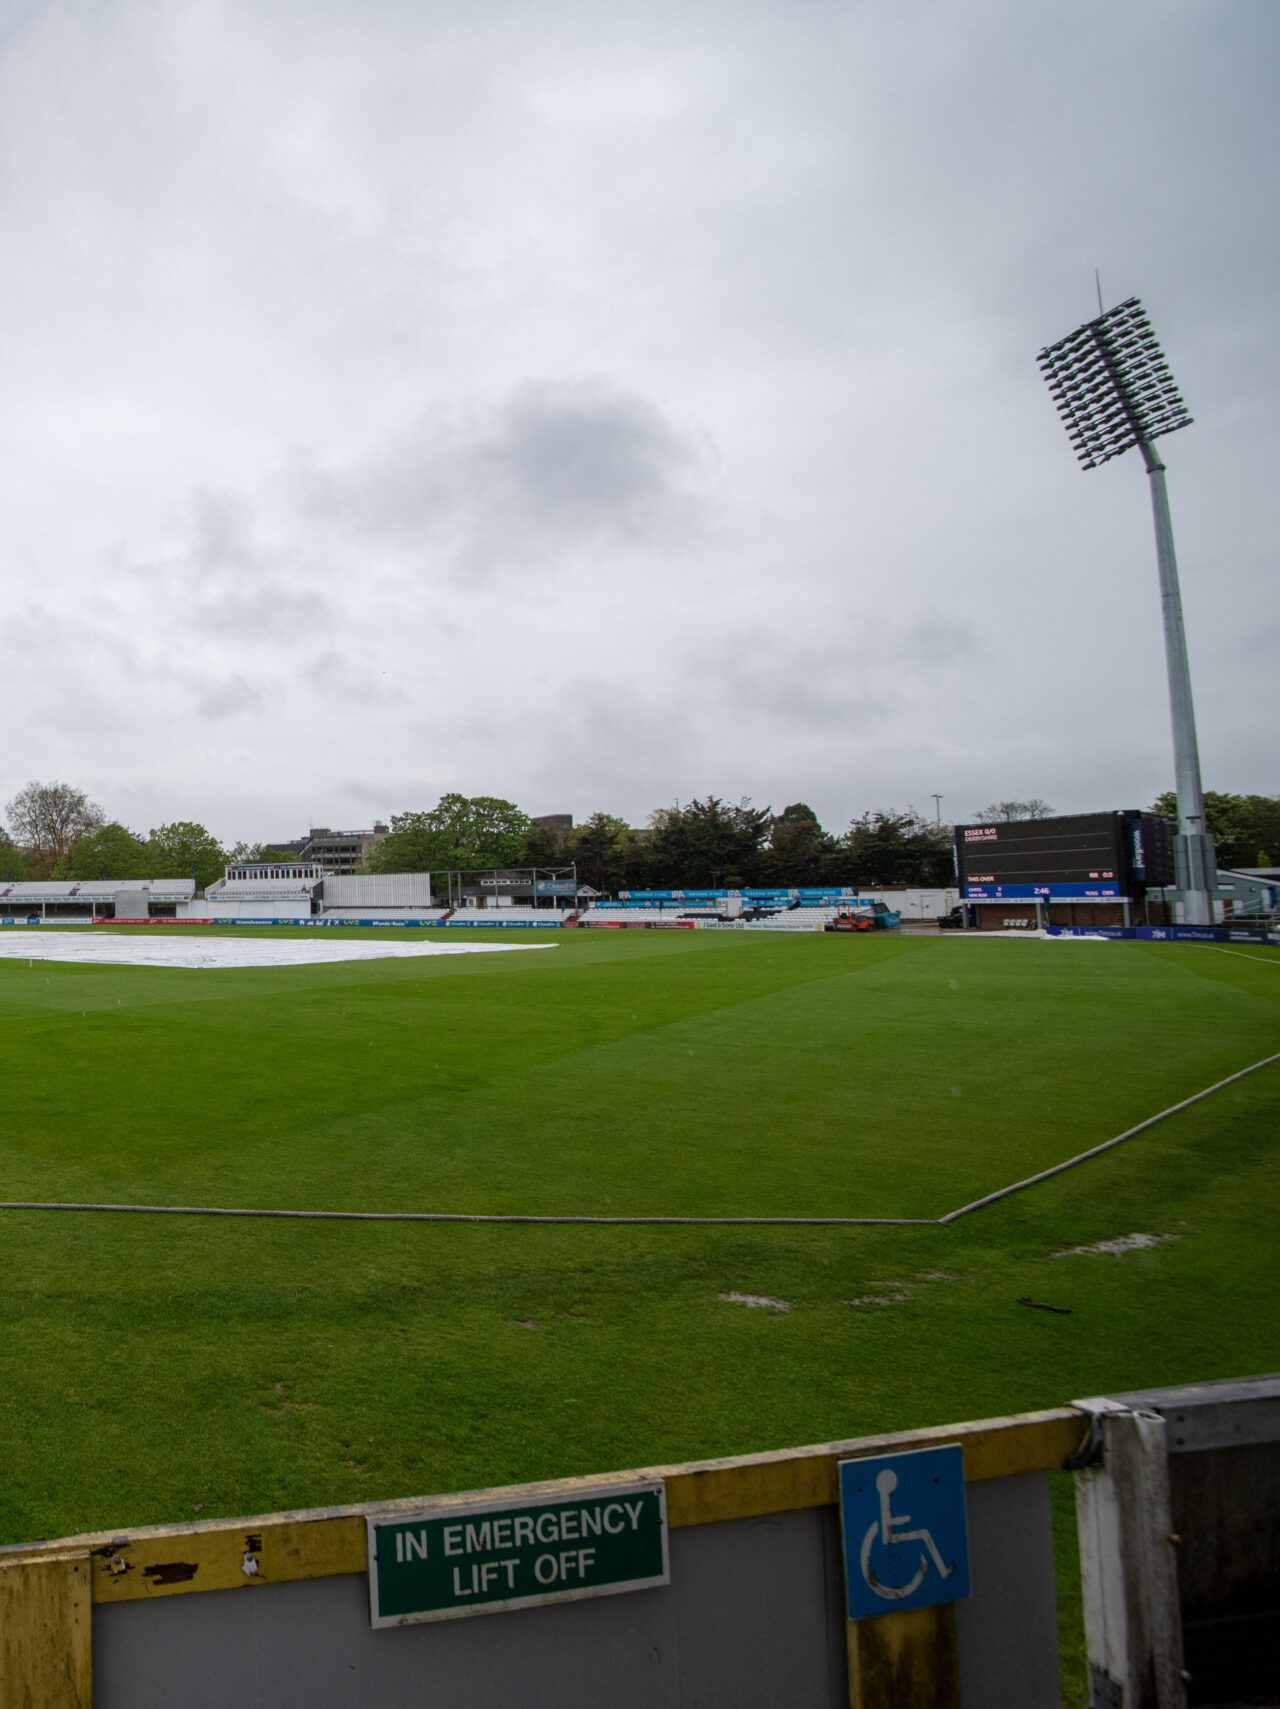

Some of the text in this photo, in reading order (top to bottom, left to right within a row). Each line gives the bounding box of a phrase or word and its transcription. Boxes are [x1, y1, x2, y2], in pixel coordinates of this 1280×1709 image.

[964, 829, 984, 837] ESSEX
[964, 834, 999, 842] DERBYSHIRE
[618, 890, 632, 899] IPA
[671, 890, 685, 898] IPA
[727, 890, 741, 898] IPA
[787, 889, 800, 898] IPA
[841, 888, 854, 896] IPA
[1033, 887, 1050, 895] 2:46
[395, 1500, 644, 1563] IN EMERGENCY
[453, 1548, 596, 1597] LIFT OFF
